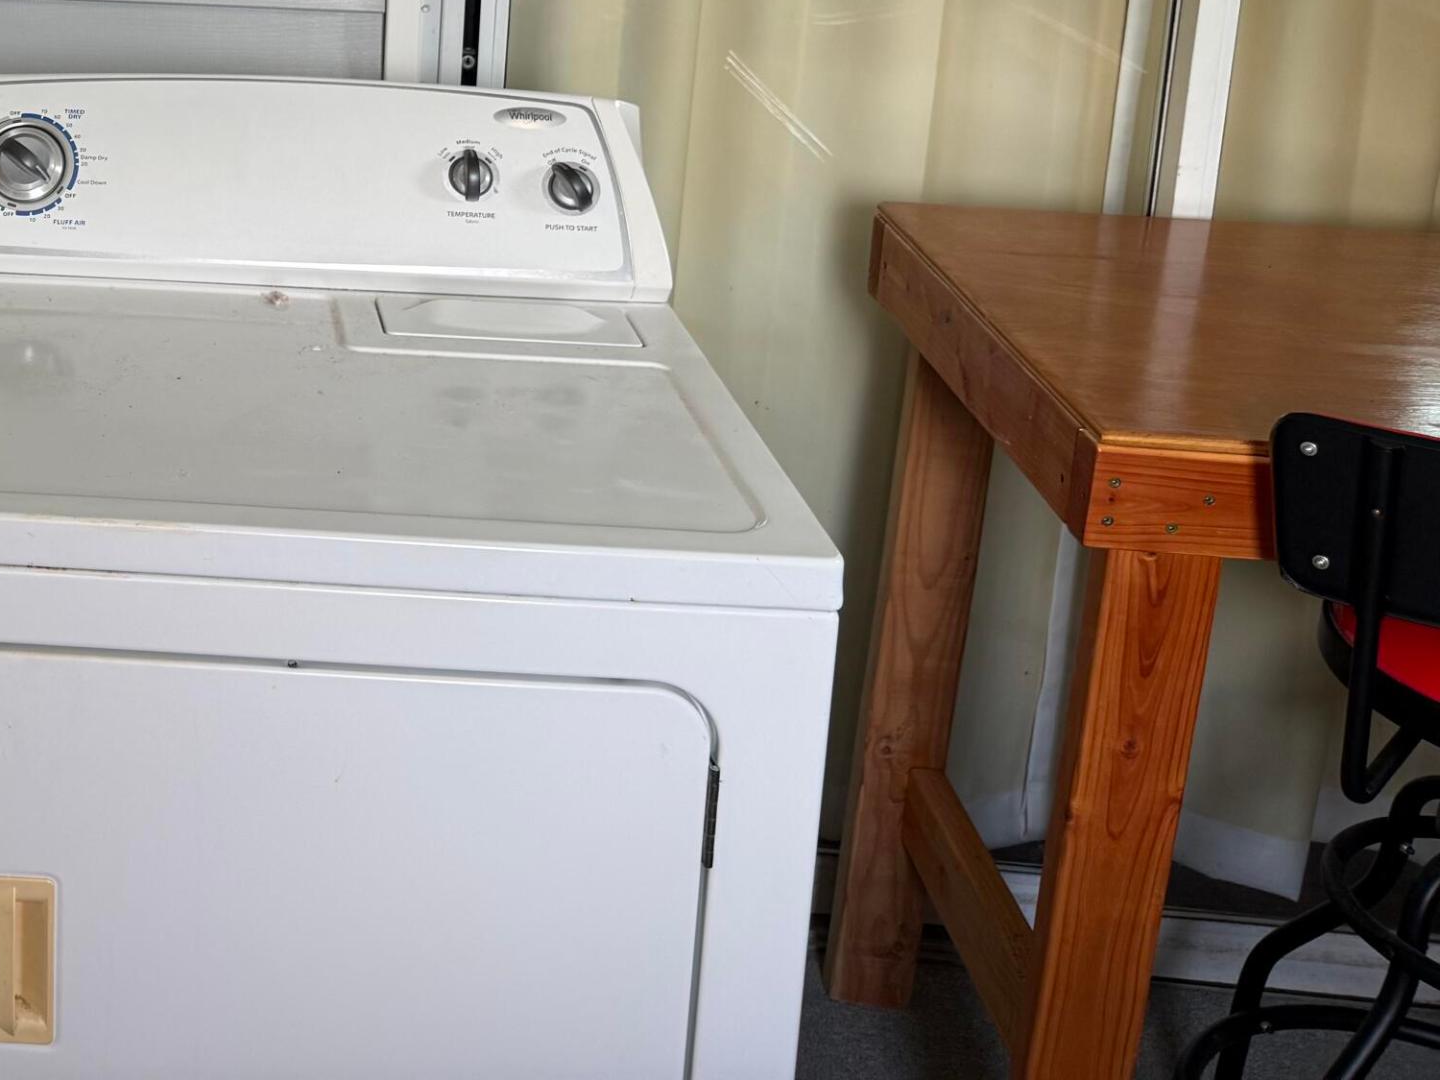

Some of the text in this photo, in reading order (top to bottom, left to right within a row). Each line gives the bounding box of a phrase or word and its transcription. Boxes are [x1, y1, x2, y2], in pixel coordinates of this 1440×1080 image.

[508, 111, 553, 122] Whirlpool
[80, 154, 96, 162] Damp
[447, 210, 496, 219] TEMPERATURE
[576, 224, 598, 232] START
